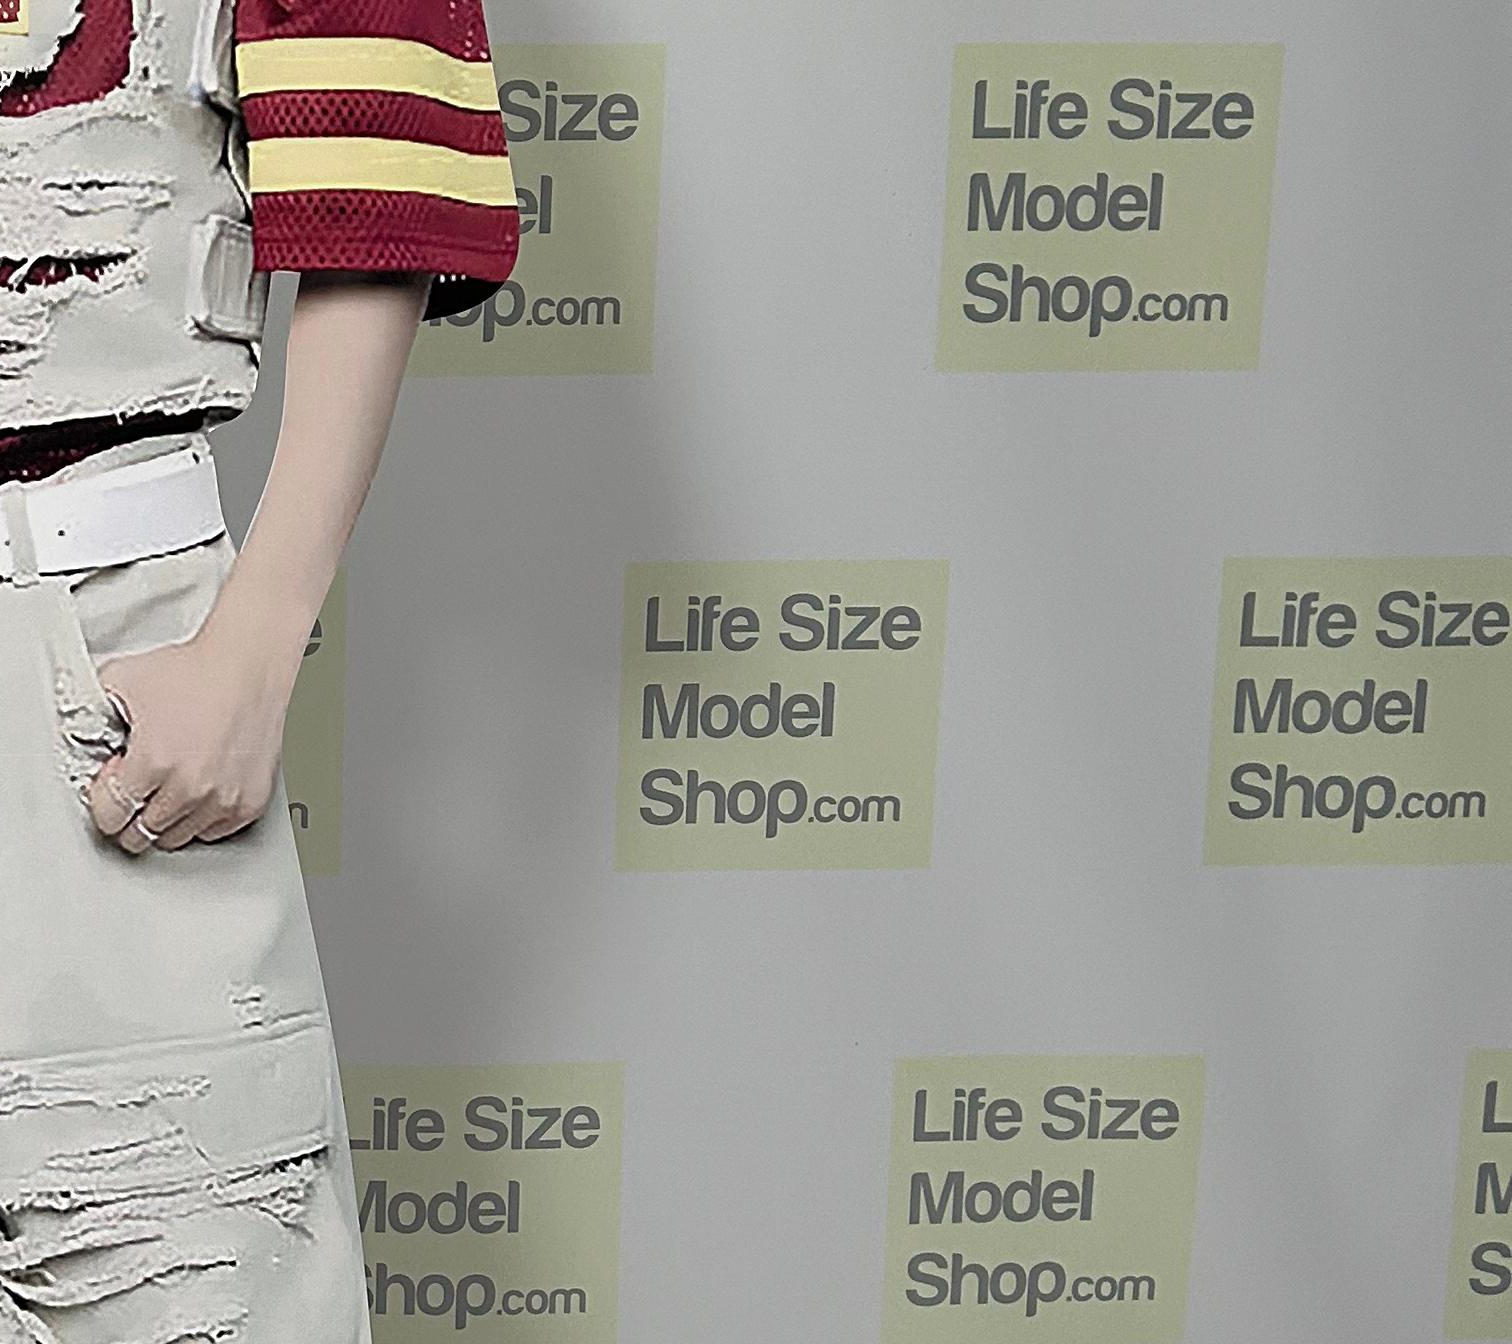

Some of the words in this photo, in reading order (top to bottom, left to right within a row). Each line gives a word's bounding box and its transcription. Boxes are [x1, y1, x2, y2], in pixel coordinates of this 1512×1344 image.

[498, 80, 638, 142] Size
[972, 80, 1088, 139] Life
[1108, 79, 1254, 140] Size
[968, 173, 1163, 231] Model
[425, 280, 620, 343] p.com
[963, 263, 1228, 337] Shop.com
[645, 596, 759, 652] Life
[779, 594, 921, 651] Size
[1240, 592, 1356, 648] Life
[1376, 591, 1510, 648] Size
[642, 682, 835, 739] Model
[1233, 679, 1428, 734] Model
[640, 769, 900, 838] Shop.com
[1228, 763, 1485, 833] Shop.com
[464, 1096, 600, 1151] Size
[913, 1088, 1022, 1142] Life
[1041, 1086, 1179, 1140] Size
[358, 1180, 520, 1234] odel
[909, 1169, 1094, 1224] Model
[365, 1262, 586, 1330] hop.com
[906, 1253, 1155, 1317] Shop.com
